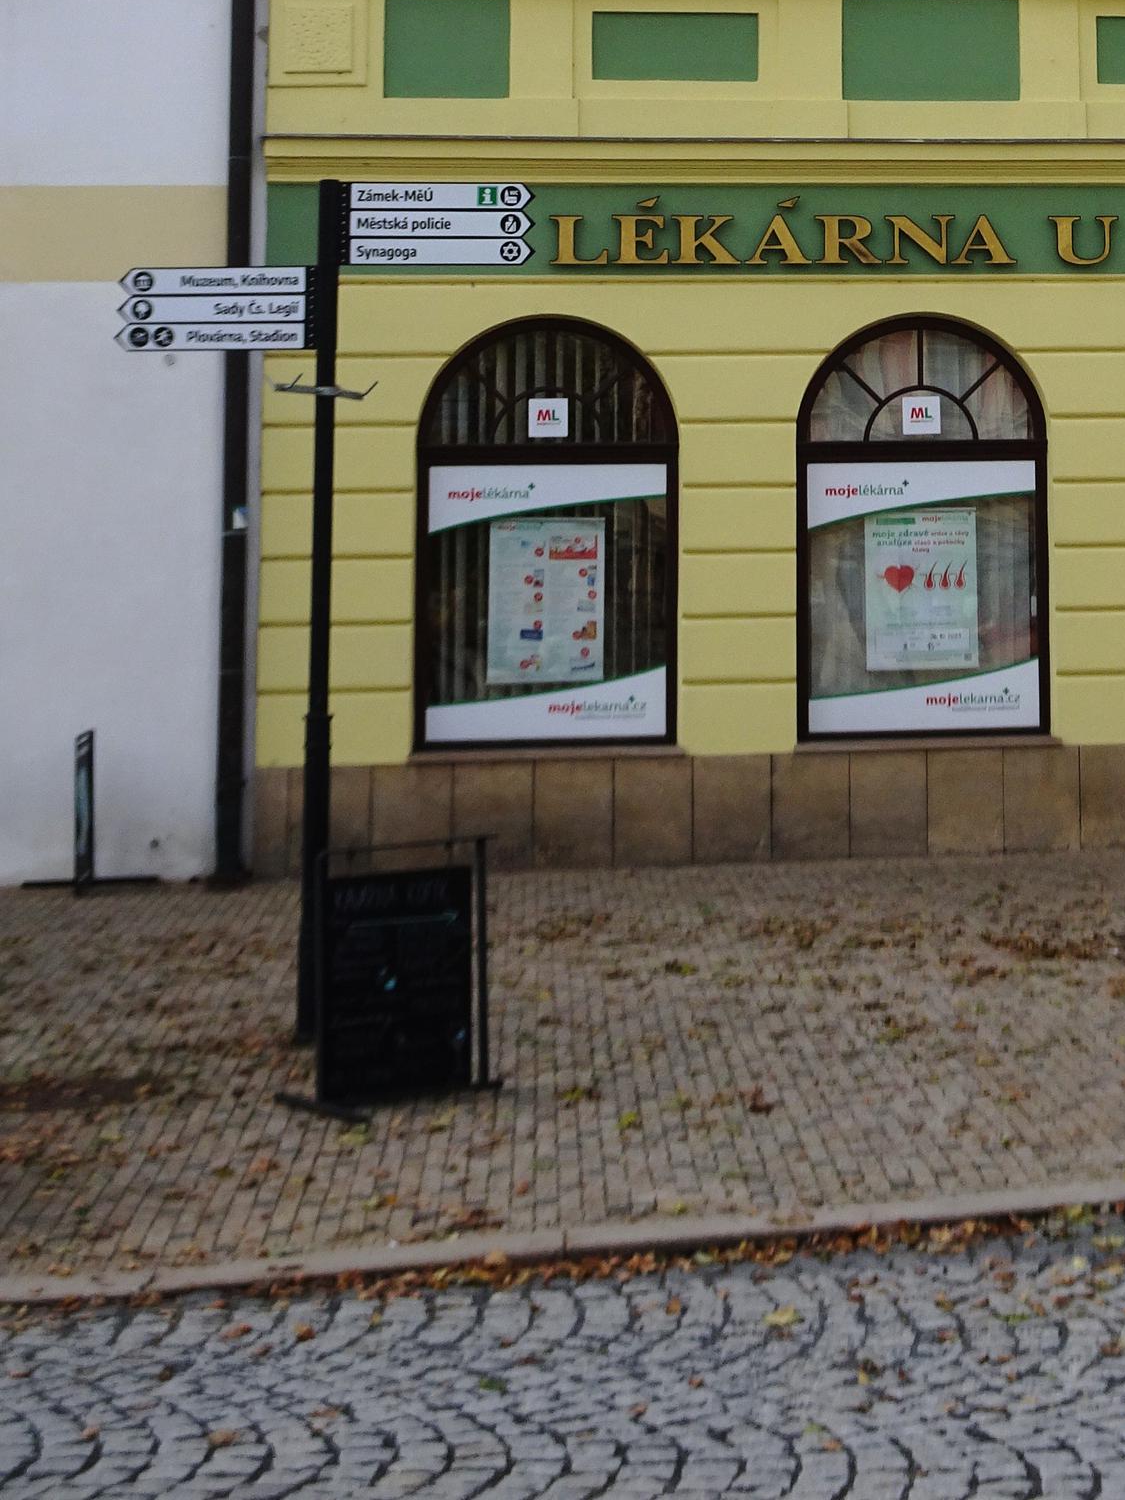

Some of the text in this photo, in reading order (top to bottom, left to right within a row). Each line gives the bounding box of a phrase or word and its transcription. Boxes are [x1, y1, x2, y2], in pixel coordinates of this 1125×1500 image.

[356, 188, 434, 203] Zámek-MěÚ
[356, 216, 452, 233] Městská policie
[549, 195, 1017, 265] LÉKÁRNA
[1048, 215, 1120, 265] U
[356, 245, 417, 261] Synagoga
[180, 273, 299, 289] Muzeum, Knihovna
[213, 302, 245, 318] Sady
[247, 301, 266, 315] Čs.
[186, 329, 298, 345] Plovárna, Stadion
[537, 409, 560, 421] ML
[910, 407, 933, 419] ML
[825, 483, 904, 499] mojelékárna
